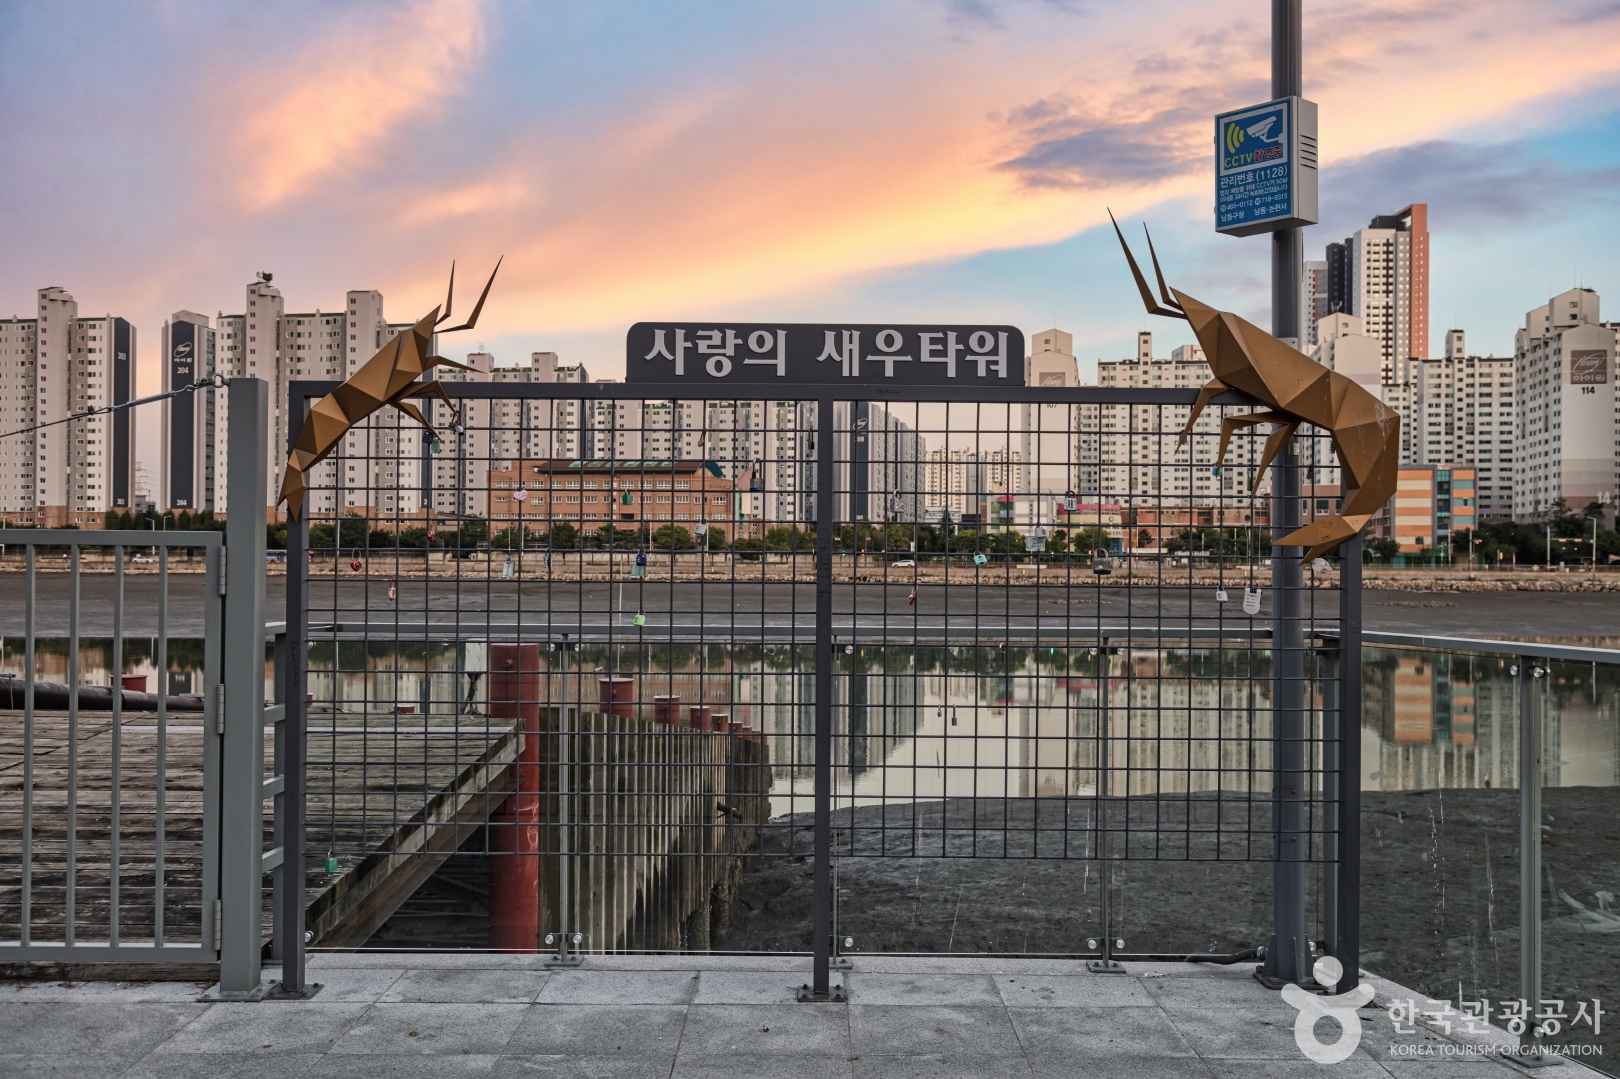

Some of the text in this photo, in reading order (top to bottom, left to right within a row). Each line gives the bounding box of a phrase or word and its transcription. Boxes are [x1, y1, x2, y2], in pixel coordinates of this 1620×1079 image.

[1224, 153, 1252, 168] CCTV
[1256, 166, 1288, 180] (1128)
[644, 329, 1010, 379] 사랑의 새우타워
[1581, 386, 1596, 395] 114
